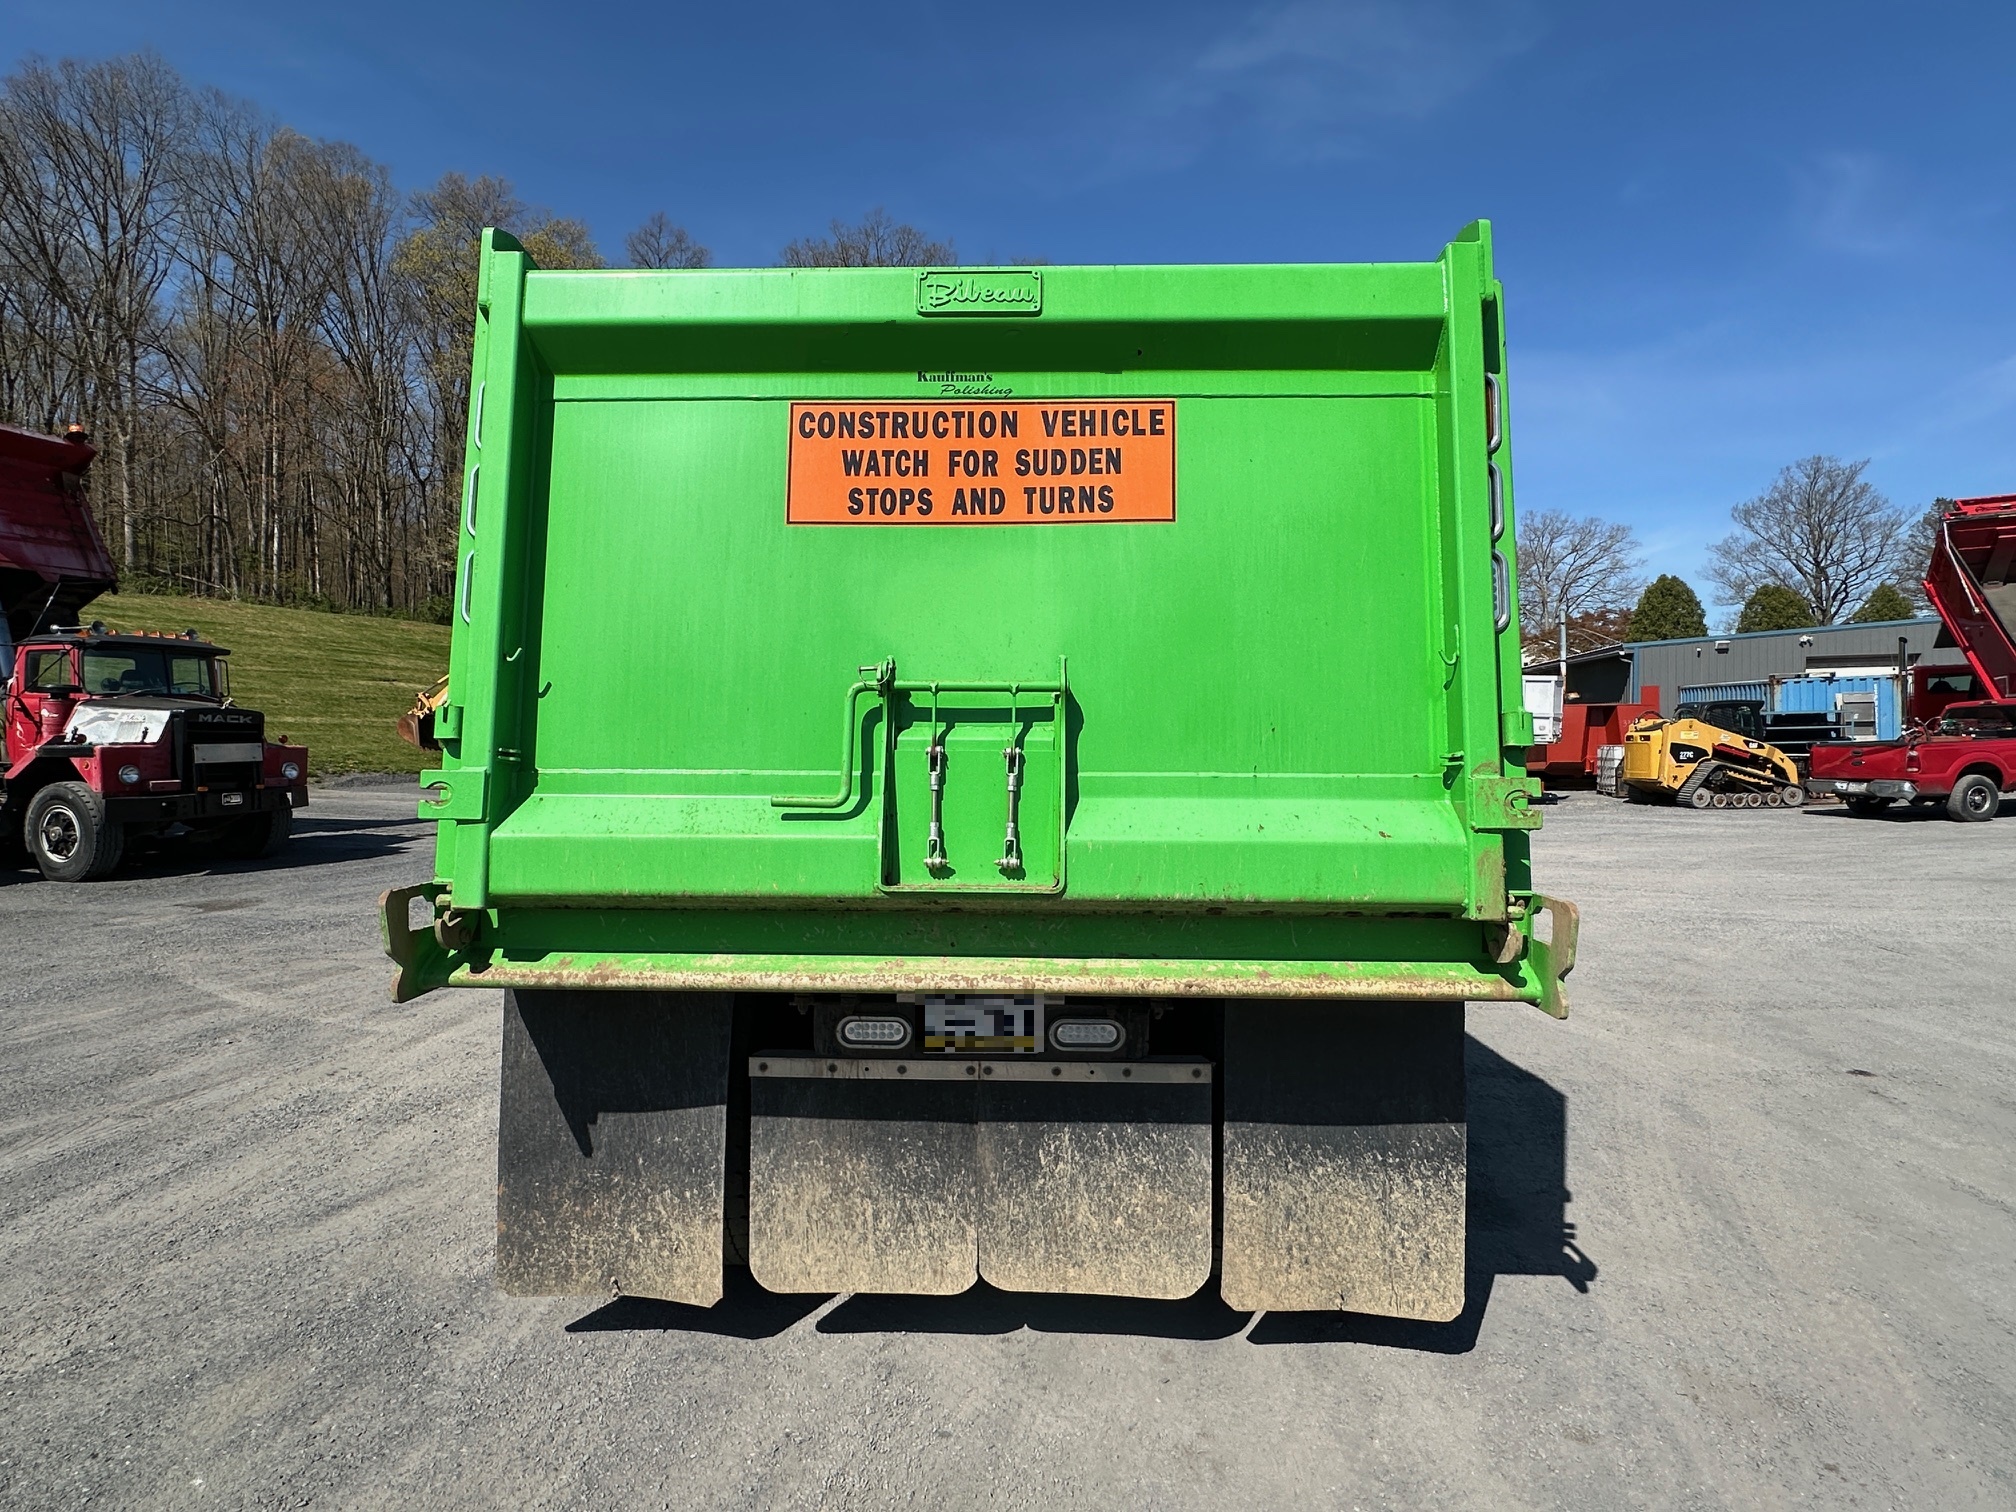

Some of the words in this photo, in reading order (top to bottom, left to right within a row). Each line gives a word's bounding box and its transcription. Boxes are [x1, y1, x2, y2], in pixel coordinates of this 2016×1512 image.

[926, 279, 1034, 308] Bibeau
[917, 370, 993, 382] Kauffman's
[940, 384, 1013, 398] Polishing
[798, 410, 1018, 439] CONSTRUCTION
[1041, 408, 1165, 437] VEHICLE
[842, 449, 929, 478] WATCH
[949, 449, 999, 478] FOR
[1015, 447, 1122, 477] SUDDEN
[847, 487, 933, 516] STOPS
[952, 487, 1006, 516] AND
[1023, 485, 1114, 514] TURNS
[198, 714, 253, 723] MACK
